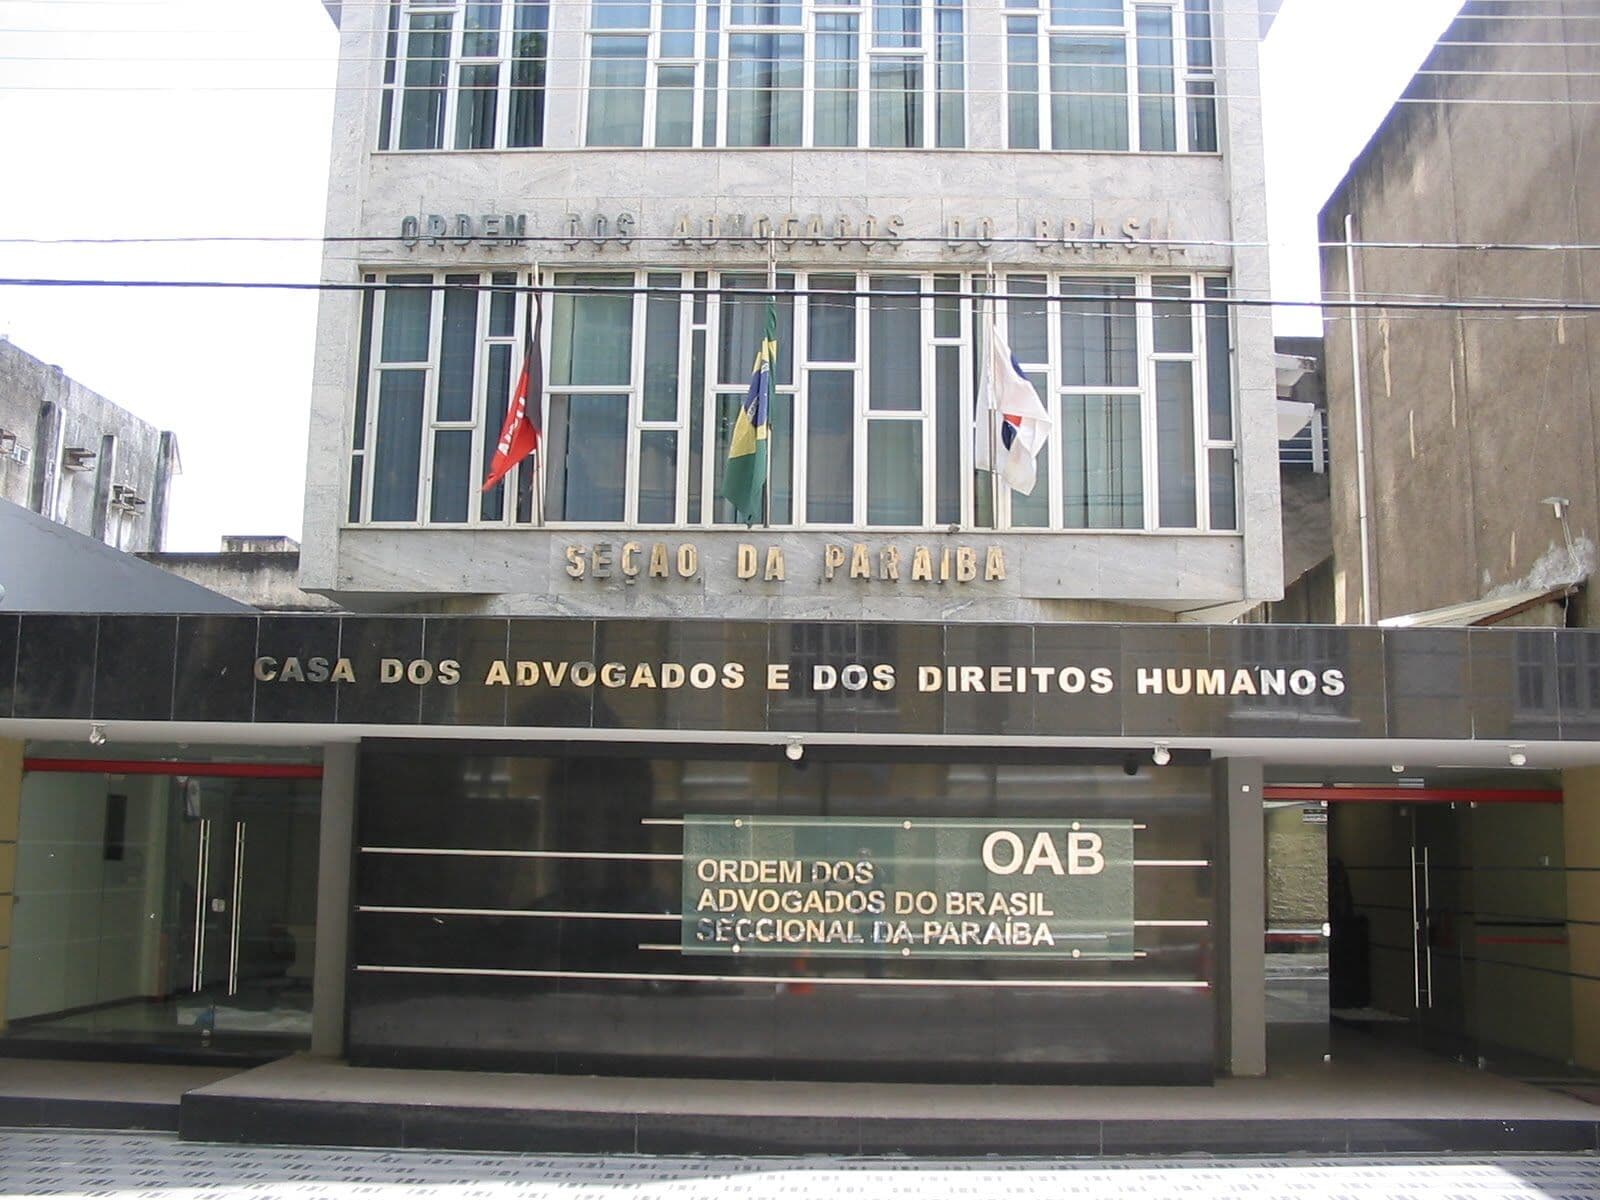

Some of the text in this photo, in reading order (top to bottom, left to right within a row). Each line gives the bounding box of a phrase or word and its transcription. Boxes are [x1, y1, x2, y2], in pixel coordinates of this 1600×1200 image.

[401, 212, 526, 248] ORDEM
[564, 213, 635, 247] DOS
[736, 543, 786, 581] DA
[253, 655, 1346, 697] CASA DOS ADVOGADOS E DOS DIREITOS HUMANOS
[981, 830, 1106, 876] OAB
[697, 859, 874, 885] ORDEM DOS
[696, 888, 1055, 917] ADVOGADOS DO BRASIL
[697, 914, 1056, 947] SECCIONAL DA PARAÍBA
